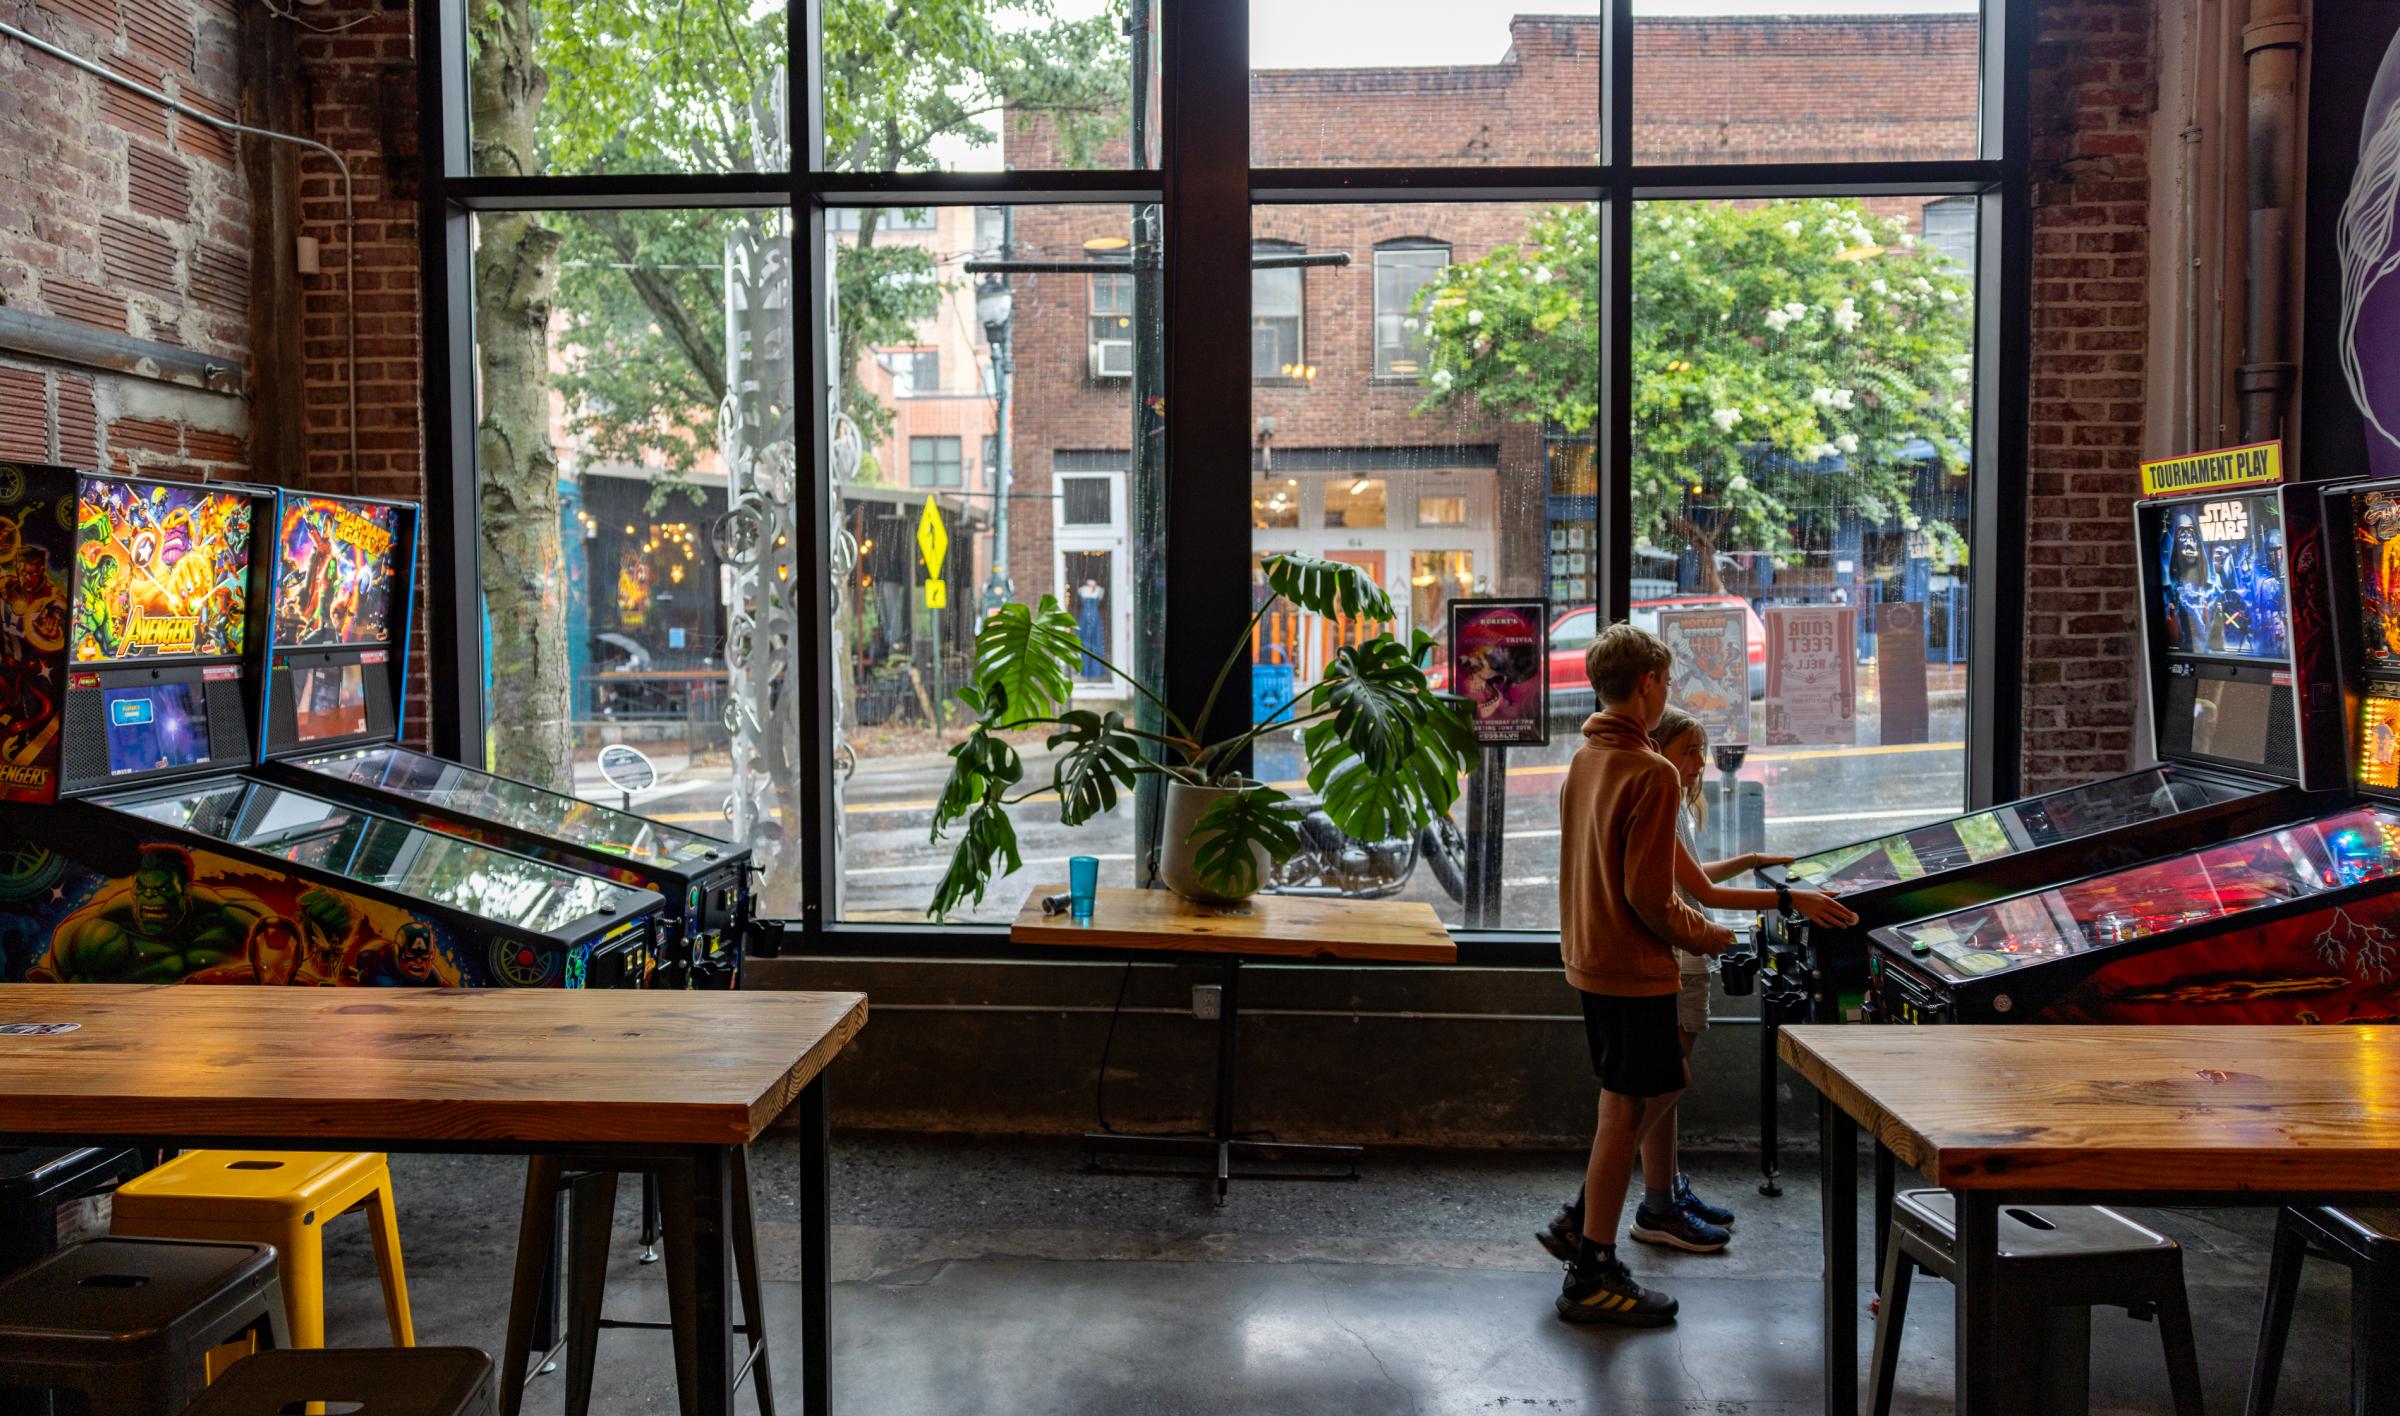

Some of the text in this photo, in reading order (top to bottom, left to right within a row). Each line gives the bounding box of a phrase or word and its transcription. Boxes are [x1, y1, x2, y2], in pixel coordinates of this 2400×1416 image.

[2149, 448, 2269, 490] TOURNAMENT PLAY
[2198, 500, 2247, 522] STAR
[2199, 520, 2248, 541] WARS
[117, 606, 199, 656] AVENGERS
[0, 764, 49, 786] ENGERS
